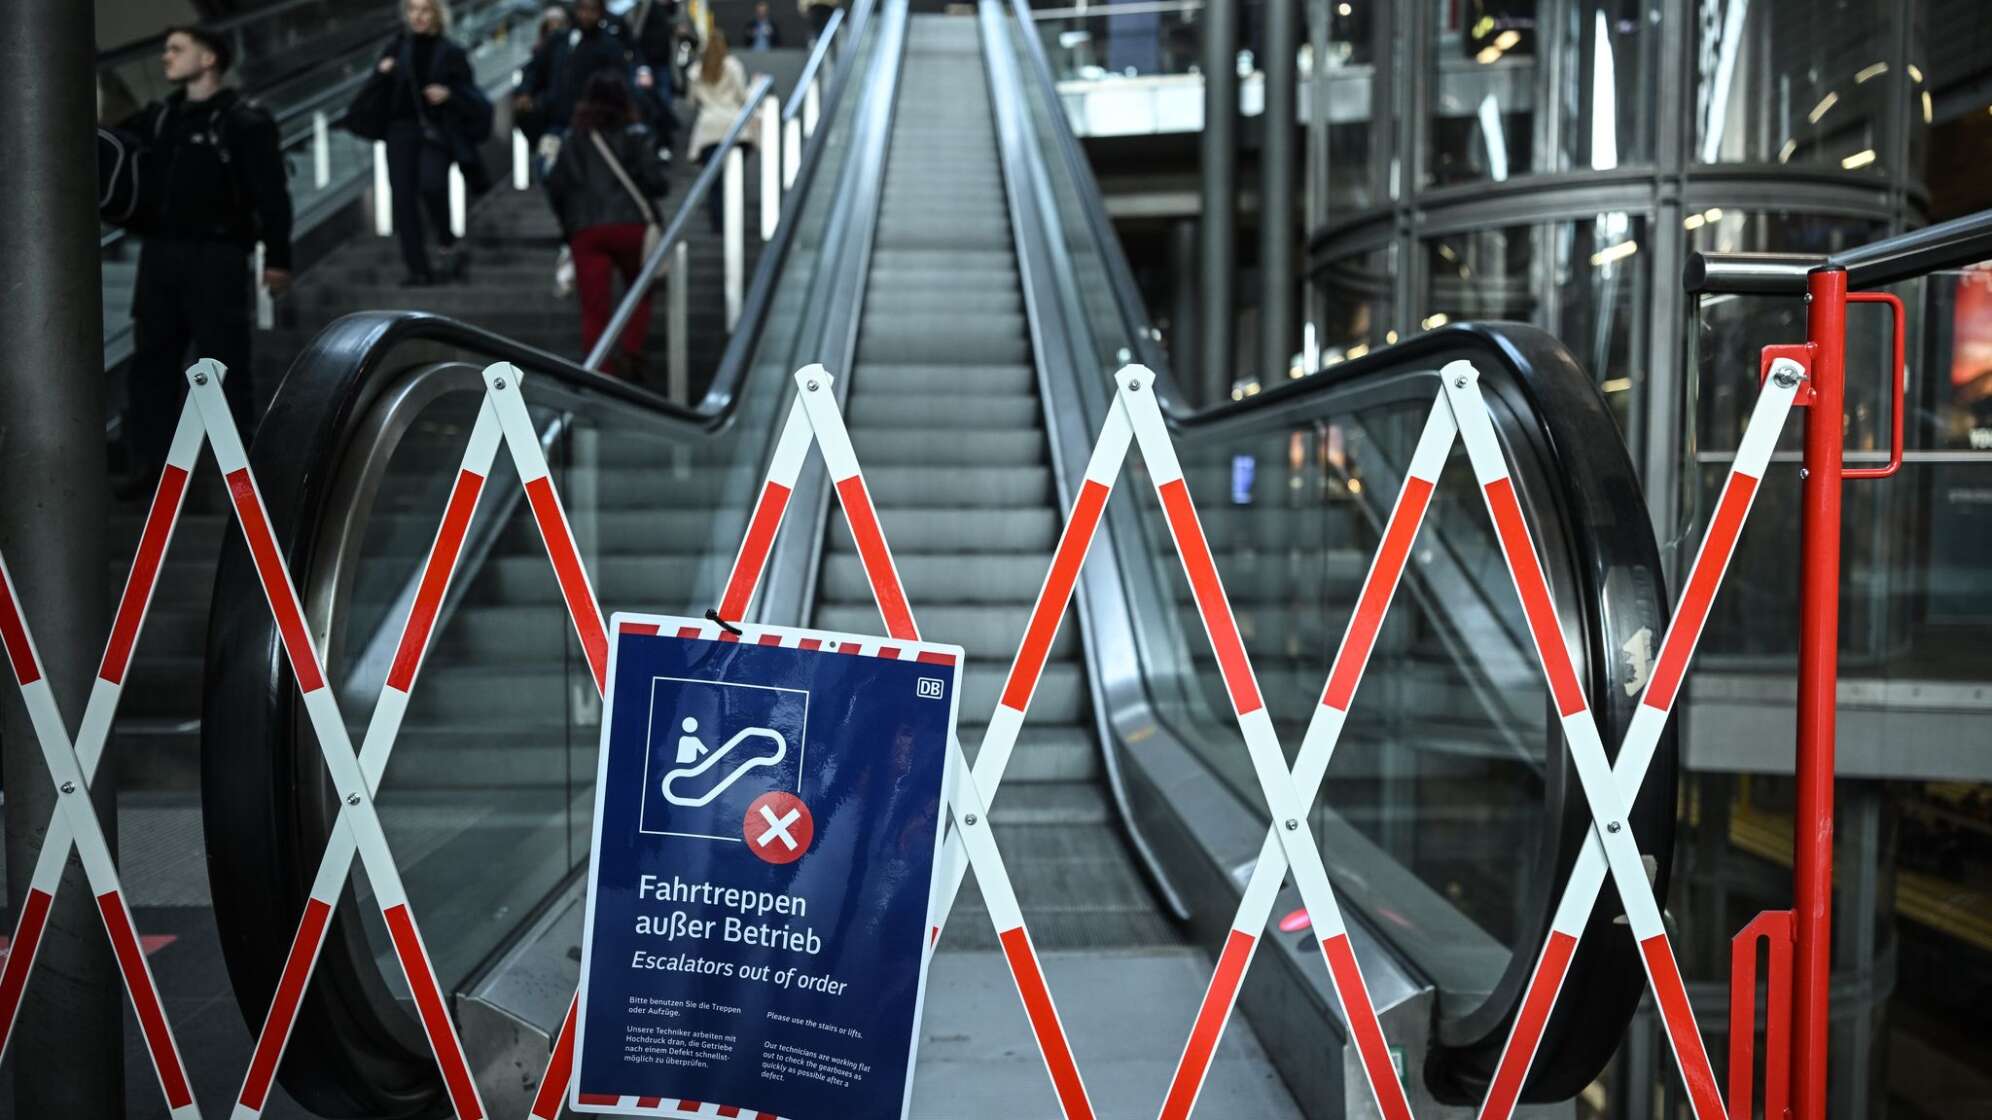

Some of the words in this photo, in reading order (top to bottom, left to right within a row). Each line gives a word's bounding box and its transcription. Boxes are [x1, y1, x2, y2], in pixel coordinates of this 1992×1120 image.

[920, 680, 941, 696] DB
[639, 874, 807, 917] Fahrtreppen
[635, 911, 716, 941] außer
[723, 917, 822, 955] Betrieb
[631, 950, 734, 976] Escalators
[738, 964, 770, 982] out
[774, 967, 797, 990] of
[797, 974, 848, 996] order
[629, 996, 648, 1005] Bitte
[650, 998, 684, 1007] benutzen
[685, 1000, 697, 1008] Sie
[712, 1003, 741, 1014] Treppen
[647, 1007, 681, 1017] Aufzüge.
[766, 1011, 790, 1022] Please
[805, 1019, 817, 1028] the
[818, 1022, 838, 1032] stairs
[847, 1028, 863, 1039] lifts.
[626, 1026, 654, 1034] Unsere
[656, 1027, 691, 1037] Techniker
[692, 1031, 723, 1040] arbeiten
[724, 1035, 737, 1043] mit
[626, 1035, 666, 1044] Hochdruck
[667, 1038, 687, 1047] dran,
[701, 1041, 733, 1051] Getriebe
[623, 1055, 654, 1064] möglich
[666, 1058, 709, 1068] überprüfen.
[669, 1048, 694, 1057] Defekt
[695, 1051, 730, 1061] schnellst-
[764, 1040, 778, 1049] Our
[779, 1044, 817, 1058] technicians
[831, 1057, 857, 1070] working
[858, 1062, 871, 1073] flat
[762, 1061, 787, 1072] quickly
[797, 1068, 826, 1081] possible
[827, 1075, 843, 1086] after
[763, 1051, 775, 1059] out
[785, 1055, 805, 1065] check
[806, 1060, 818, 1068] the
[818, 1064, 852, 1078] gearboxes
[760, 1071, 785, 1082] defect.
